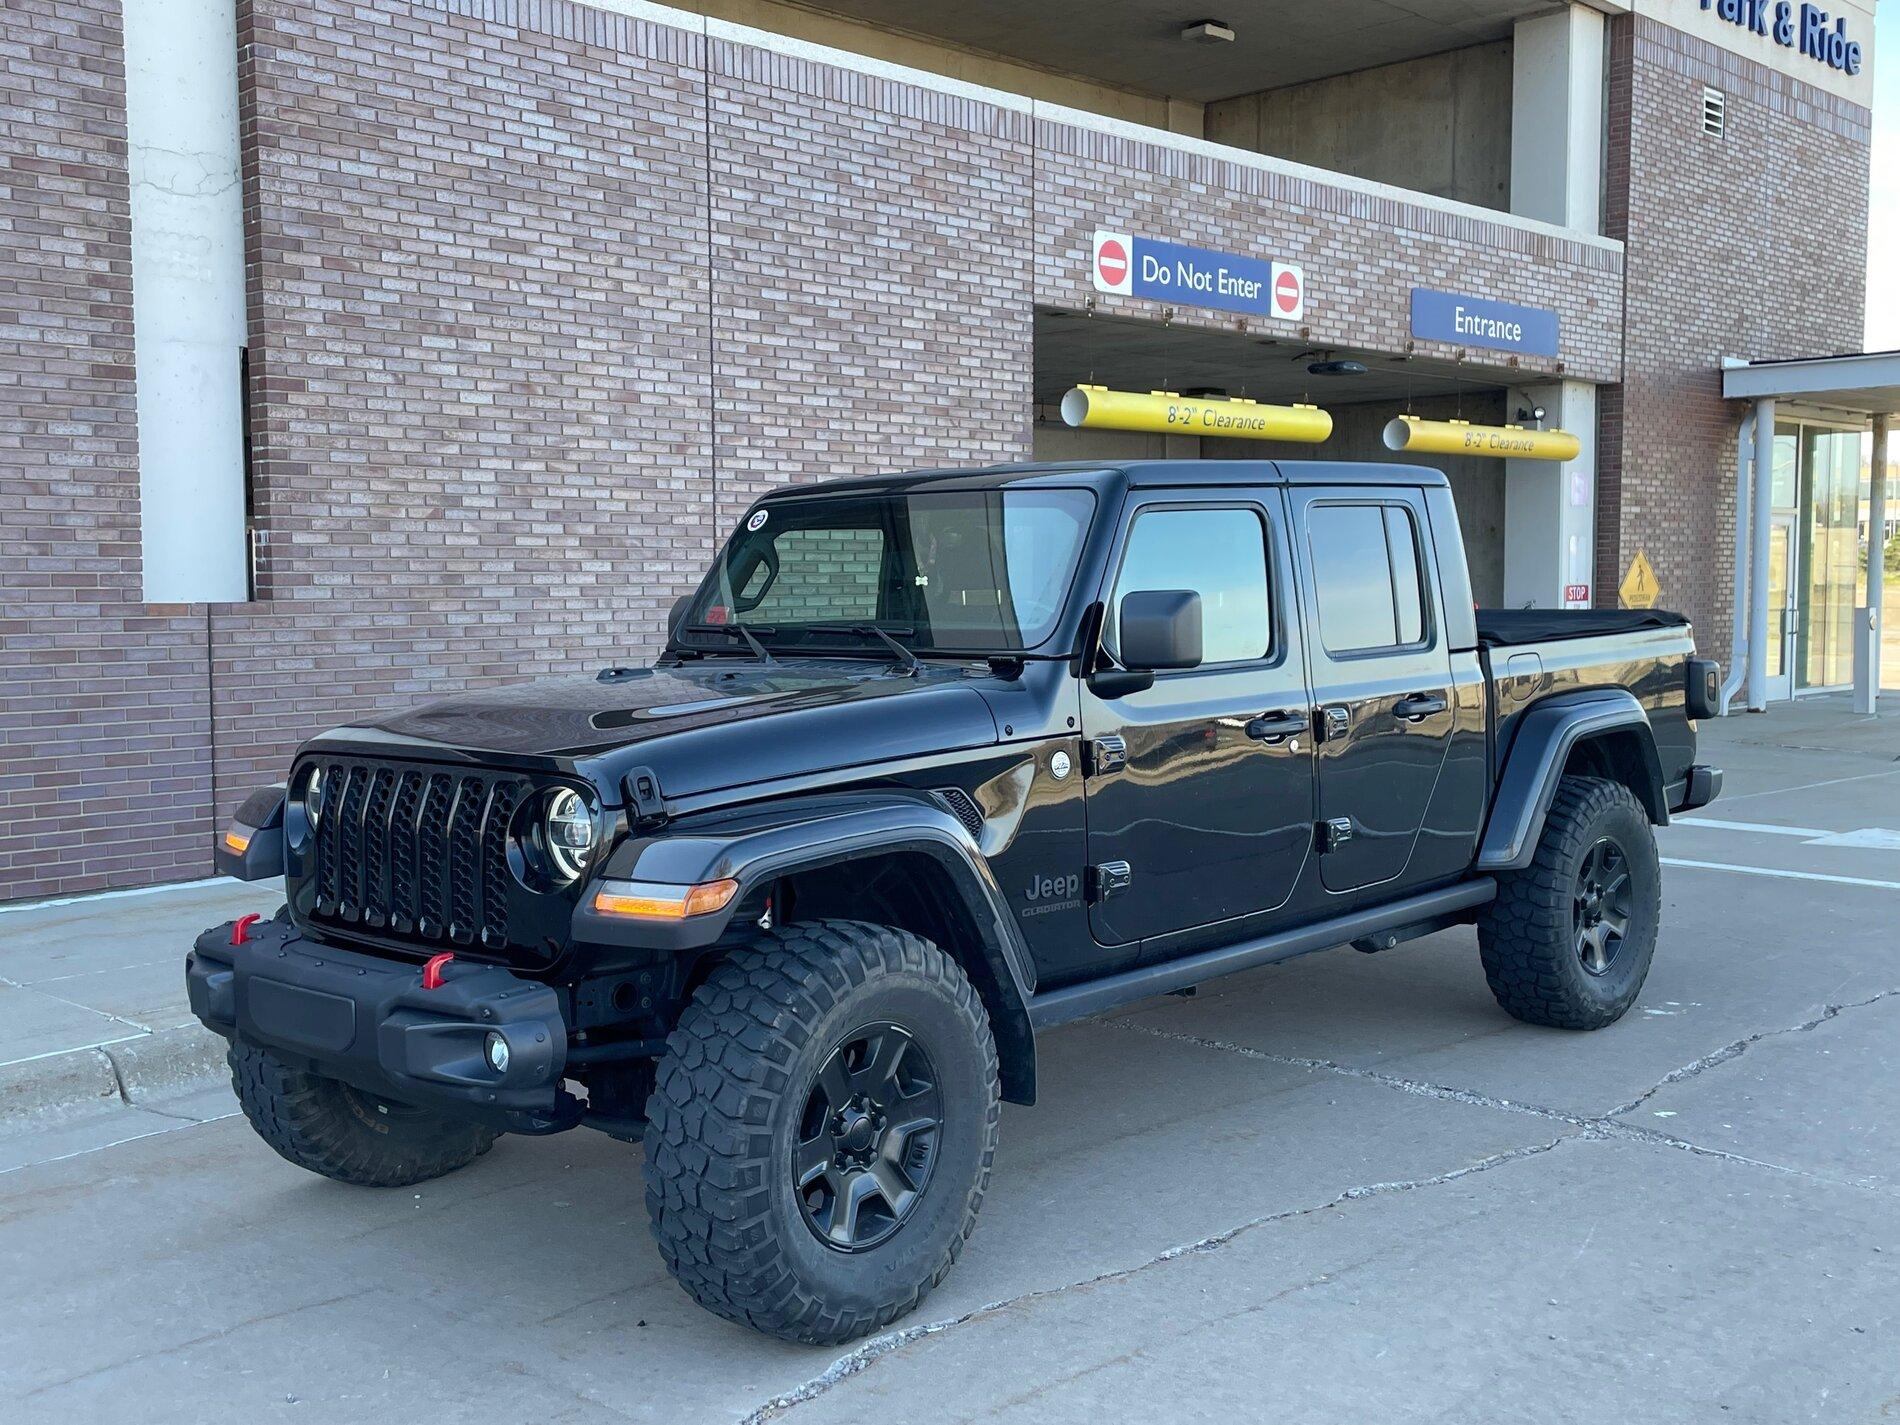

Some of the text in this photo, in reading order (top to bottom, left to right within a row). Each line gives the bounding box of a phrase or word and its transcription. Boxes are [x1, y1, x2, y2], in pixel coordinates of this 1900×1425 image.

[1773, 1, 1794, 47] &
[1800, 3, 1861, 76] Ride
[1143, 255, 1262, 299] Do Not Enter
[1455, 306, 1522, 342] Entrance
[1203, 409, 1265, 430] Clearance
[1489, 433, 1534, 451] Clearance
[1568, 586, 1586, 600] STOP
[1024, 874, 1079, 900] Jeep
[1022, 900, 1081, 917] GLADIATOR
